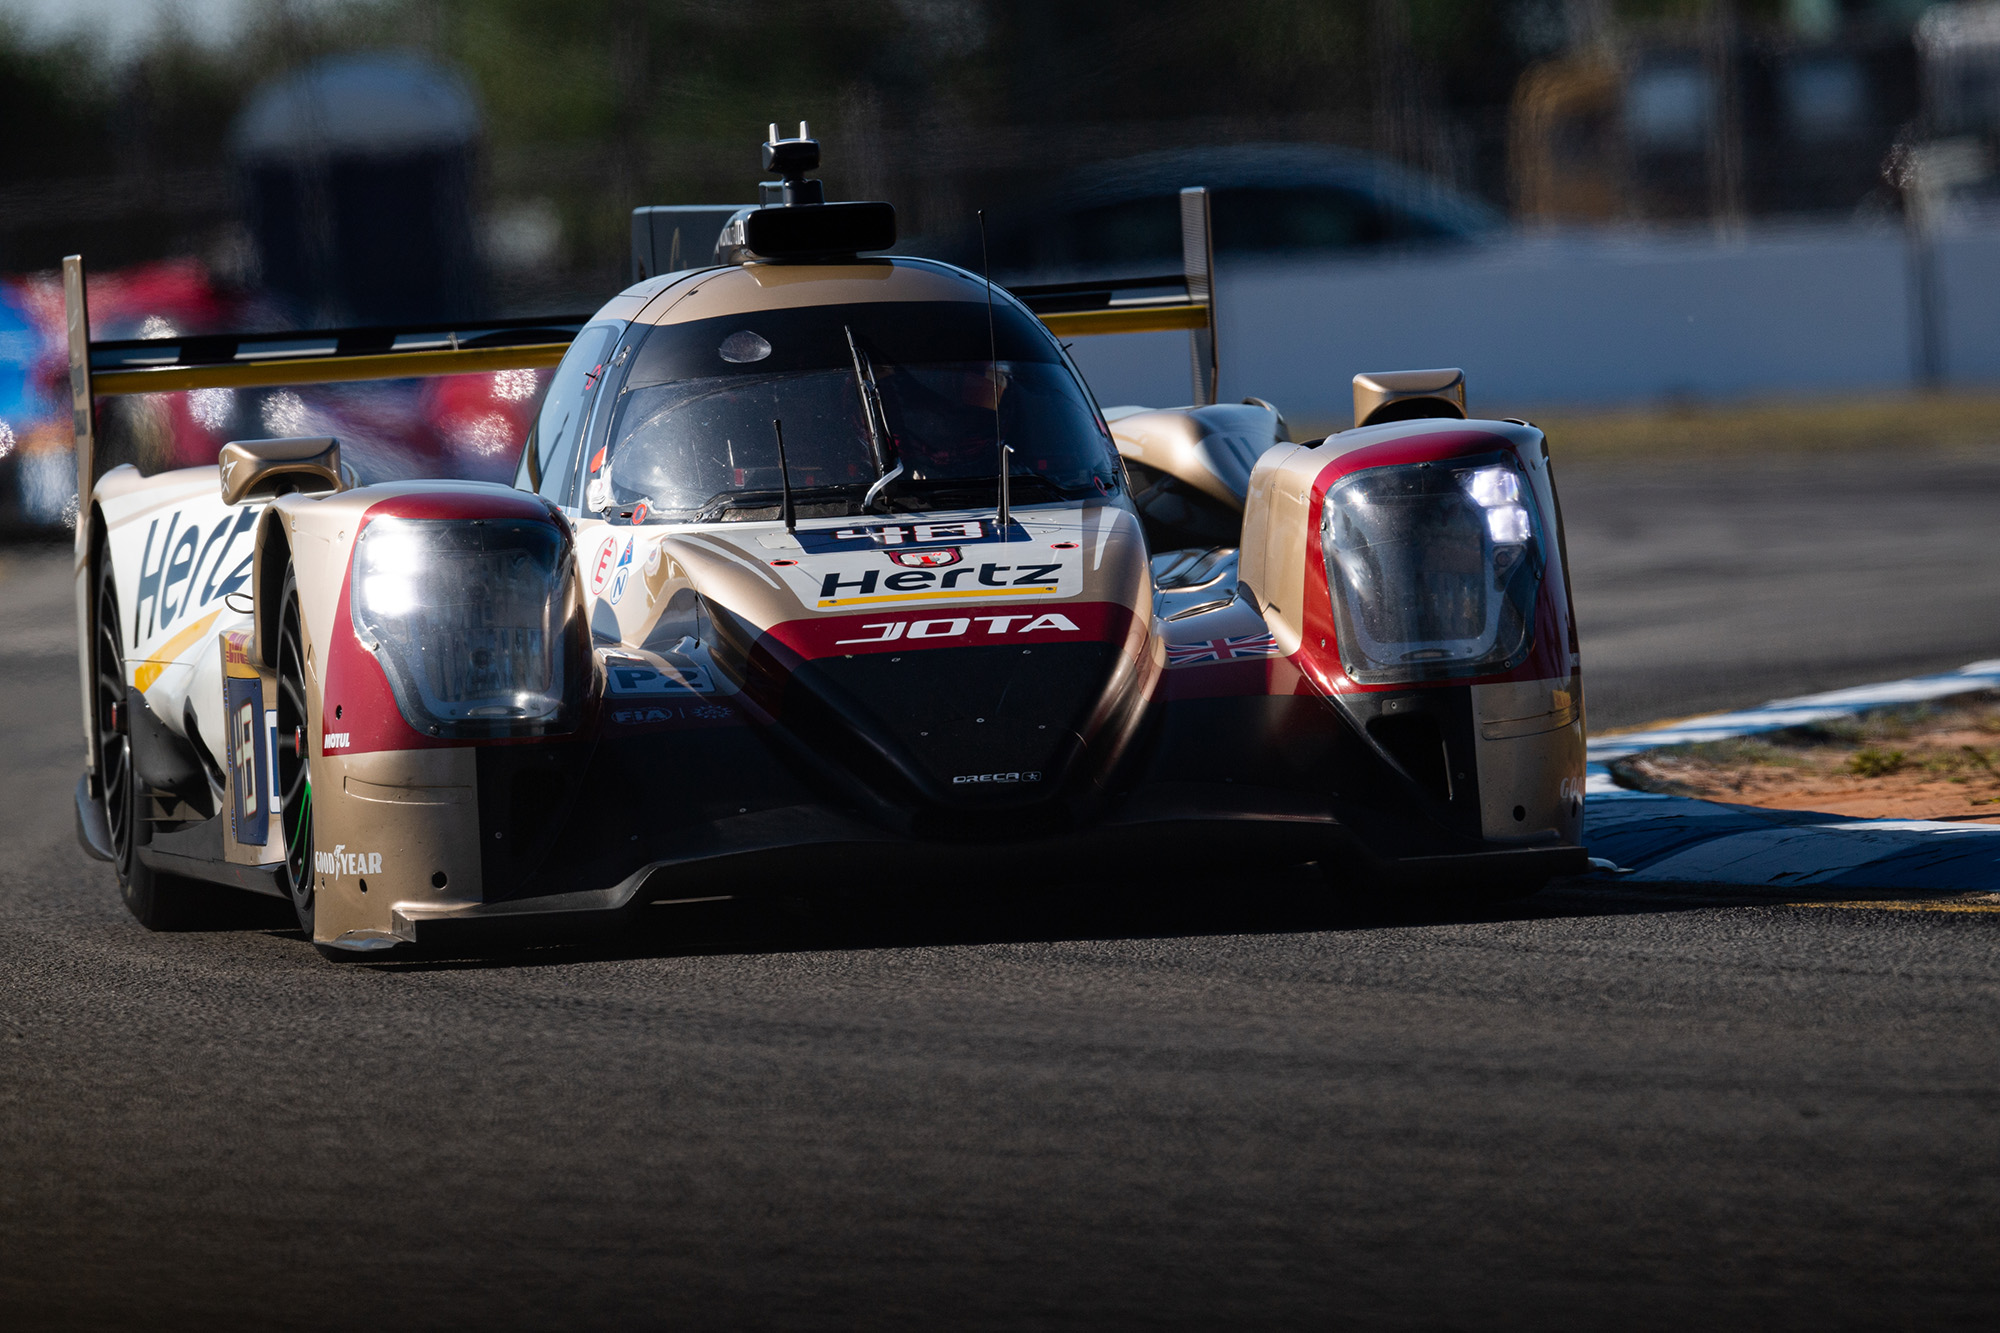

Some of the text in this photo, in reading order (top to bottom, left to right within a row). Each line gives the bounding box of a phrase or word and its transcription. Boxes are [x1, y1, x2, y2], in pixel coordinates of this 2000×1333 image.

[836, 521, 984, 545] 48
[133, 505, 260, 650] Hertz
[595, 547, 613, 584] E
[613, 574, 627, 598] N
[820, 563, 1063, 597] Hertz
[835, 613, 1081, 645] JOTA
[615, 668, 704, 689] P2
[614, 710, 668, 723] FIA
[323, 732, 351, 750] MOTUL
[952, 772, 1020, 784] ORECA
